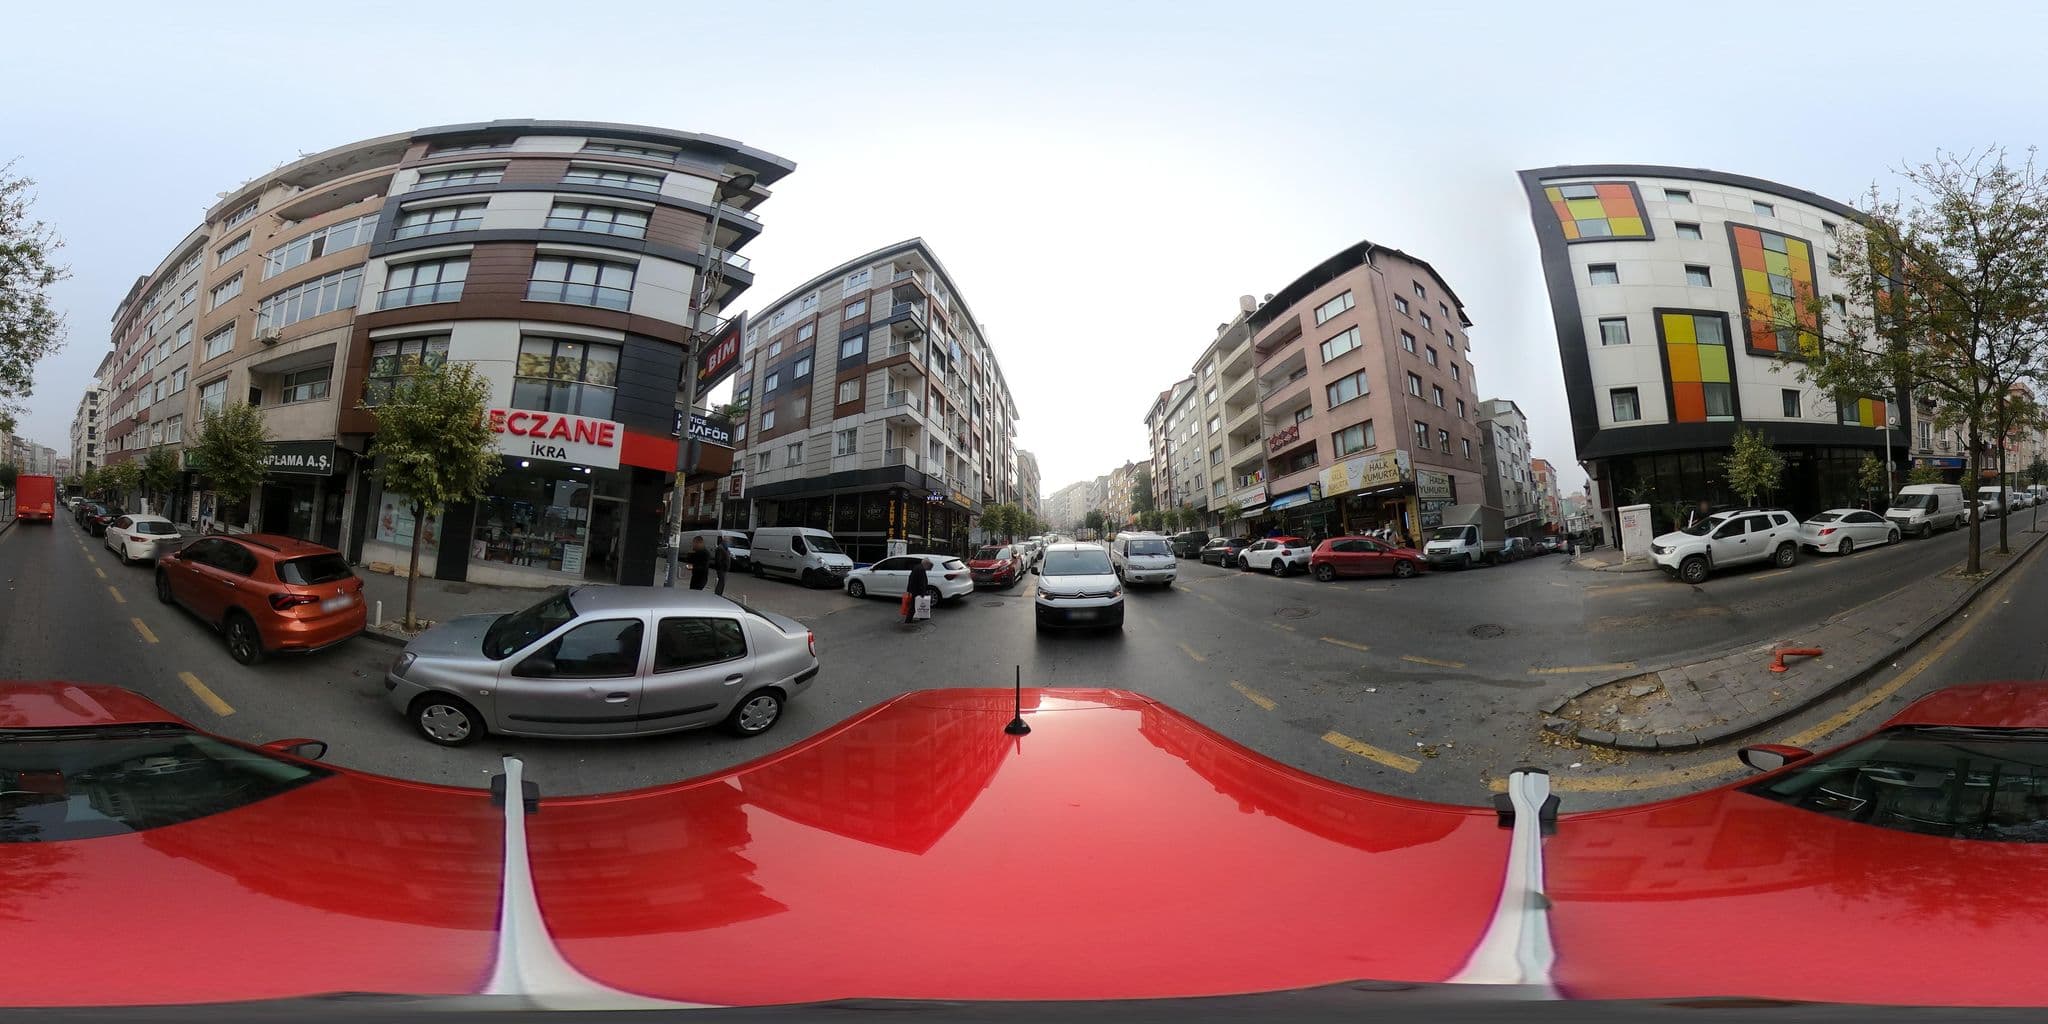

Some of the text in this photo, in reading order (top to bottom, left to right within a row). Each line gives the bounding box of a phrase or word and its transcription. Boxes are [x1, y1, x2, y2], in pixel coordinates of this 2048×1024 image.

[488, 409, 616, 448] ECZANE
[530, 440, 567, 459] İKRA
[306, 454, 331, 471] A.Ş.
[1369, 461, 1389, 472] HALK
[1362, 468, 1398, 483] YUMURTA
